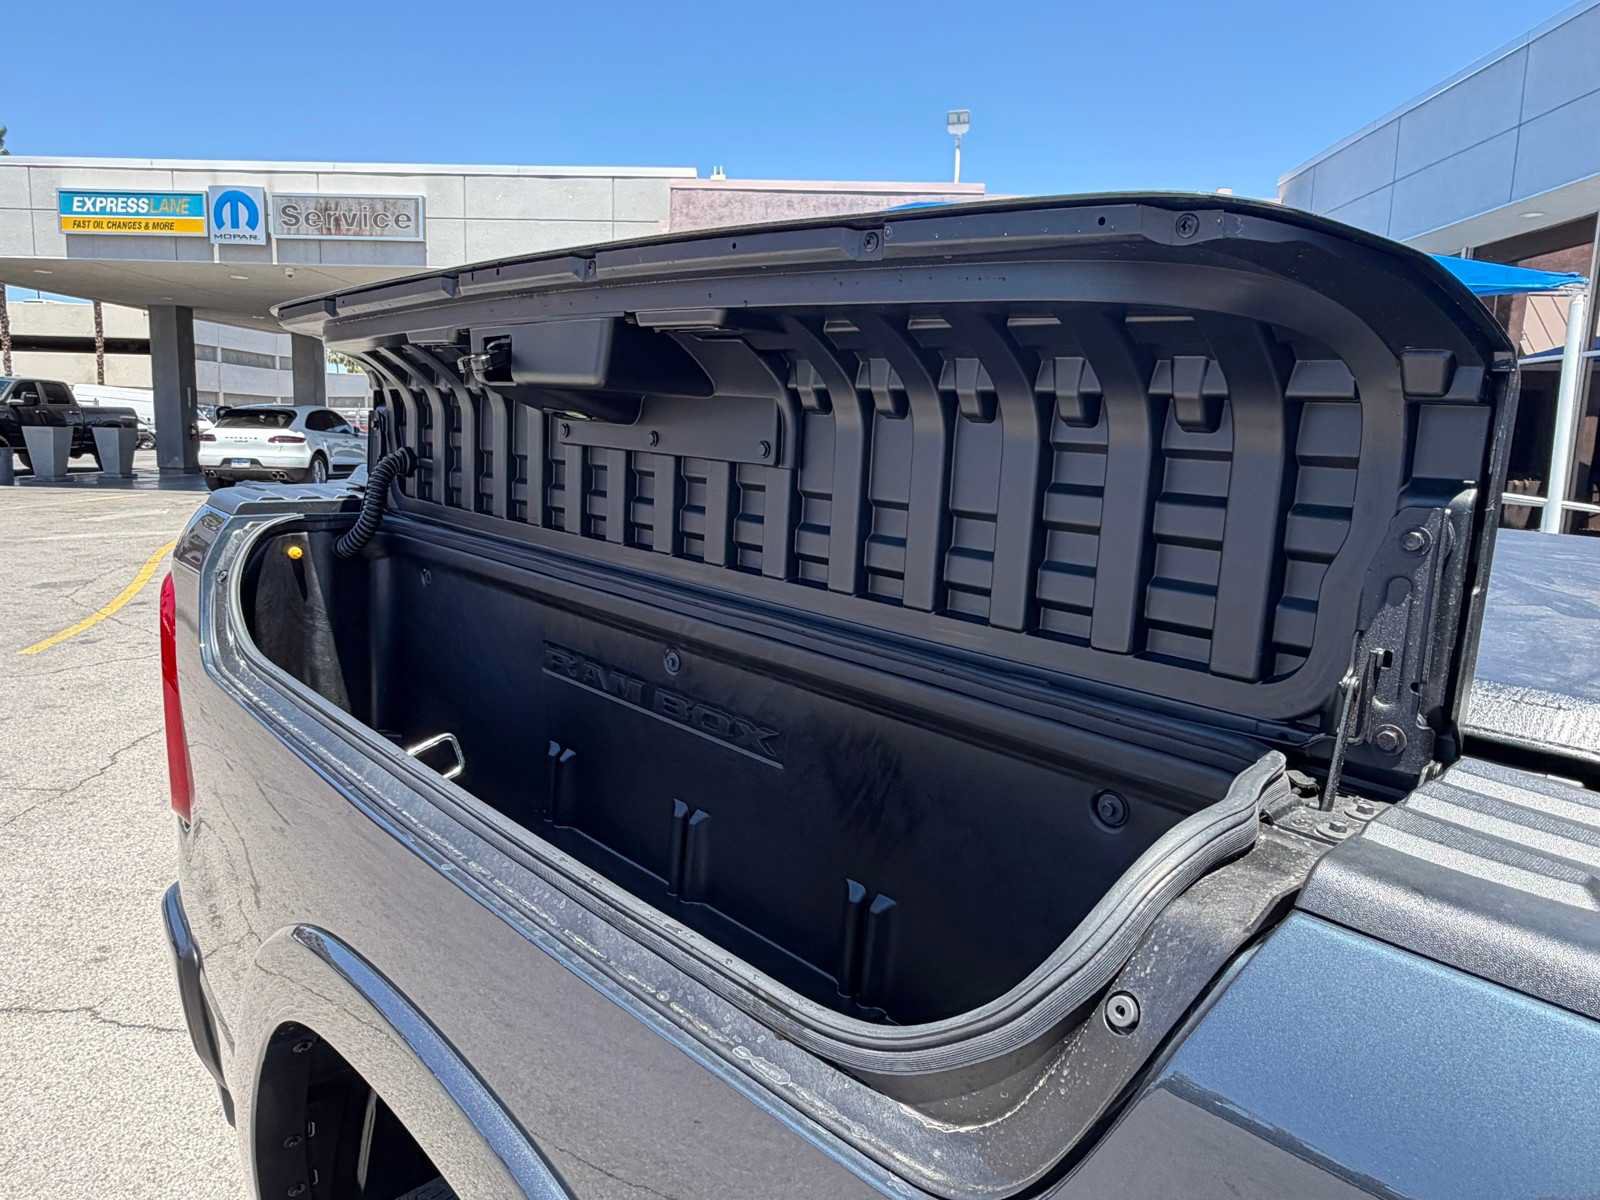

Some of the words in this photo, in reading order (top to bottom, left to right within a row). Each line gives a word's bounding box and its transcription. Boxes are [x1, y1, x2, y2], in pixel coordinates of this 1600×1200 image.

[72, 220, 91, 229] FAST
[93, 220, 104, 229] OIL
[107, 221, 142, 230] CHANGES
[144, 222, 149, 230] &
[151, 222, 175, 230] MORE
[281, 205, 411, 229] Service
[543, 646, 647, 702] RAM
[654, 687, 780, 758] BOX
